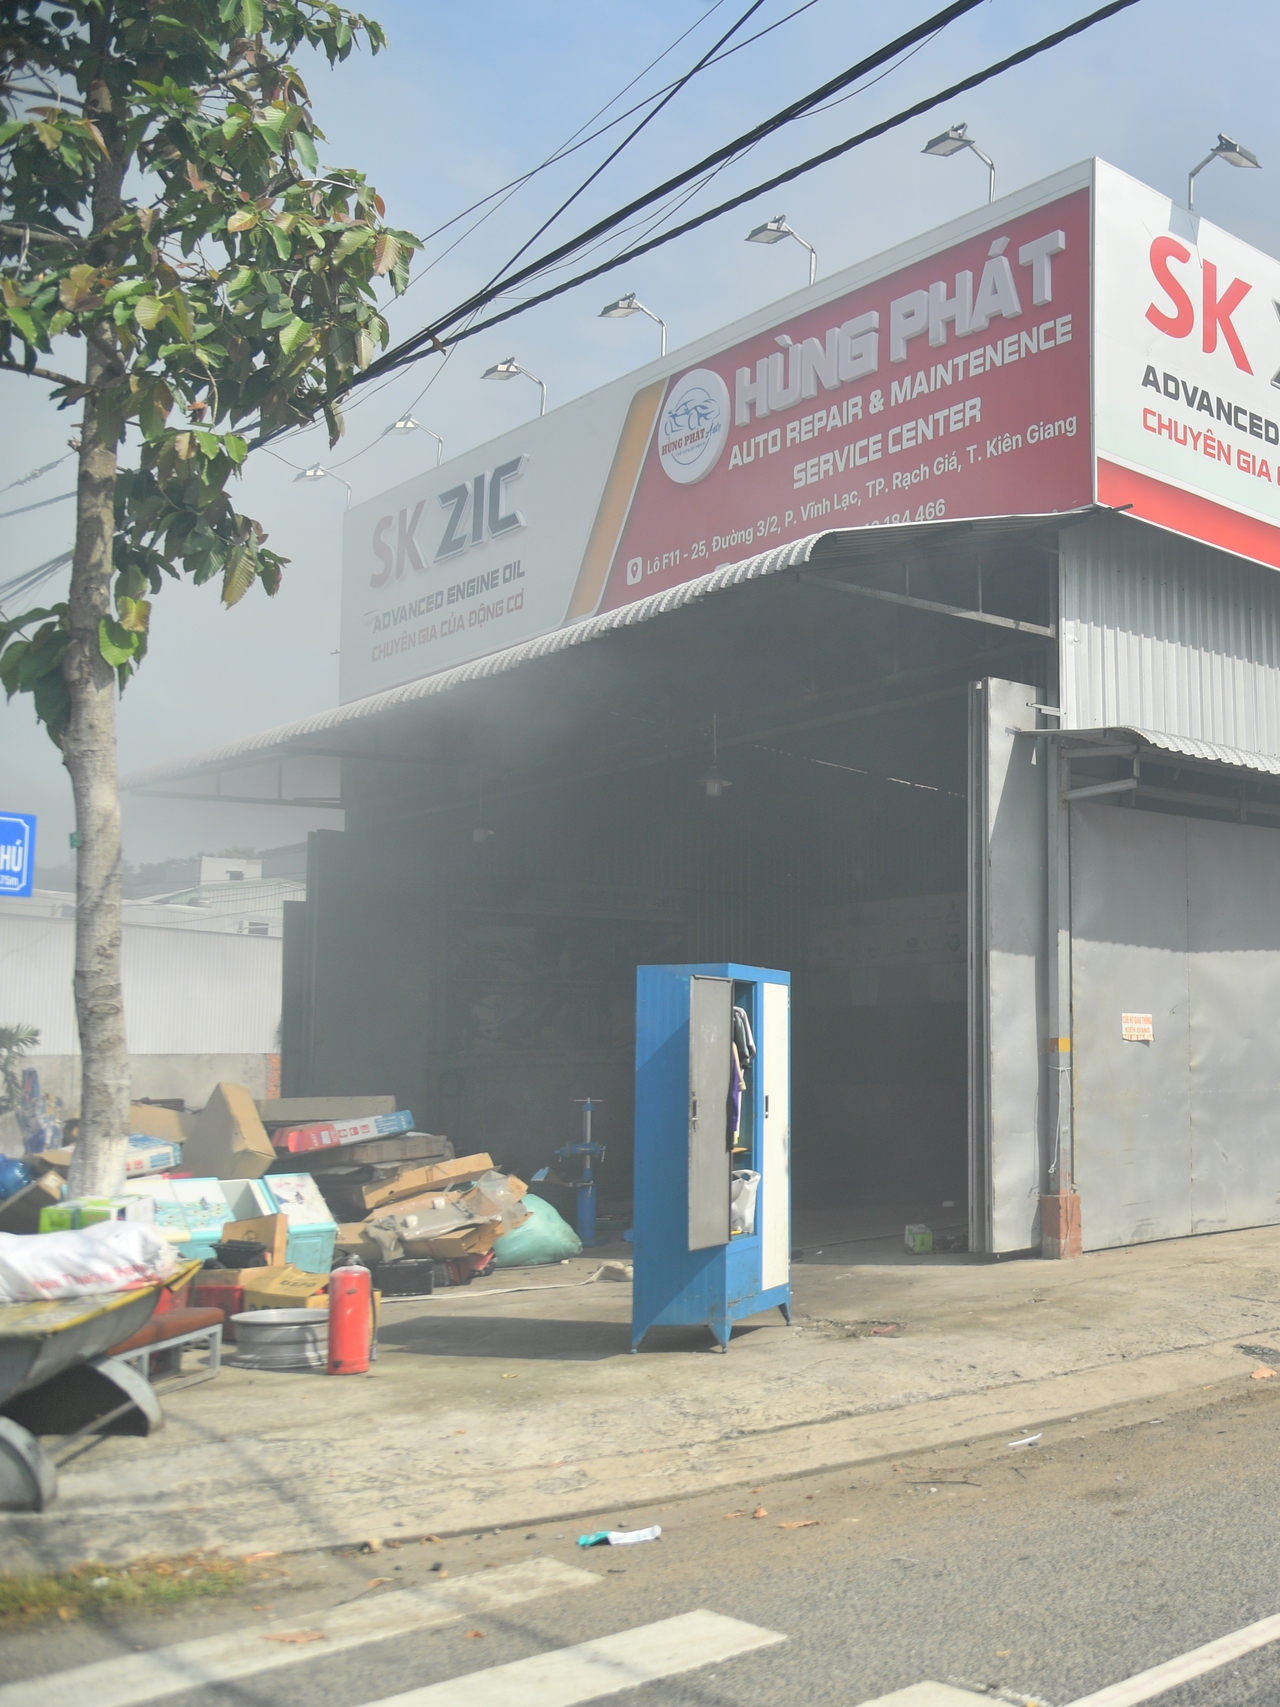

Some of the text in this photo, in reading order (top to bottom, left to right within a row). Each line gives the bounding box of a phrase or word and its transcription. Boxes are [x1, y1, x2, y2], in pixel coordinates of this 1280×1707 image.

[735, 229, 1065, 426] HÙNG PHÁT
[1144, 235, 1255, 377] SK
[728, 313, 1072, 471] AUTO REPAIR & MAINTENENCE
[1141, 364, 1280, 446] ADVANCED
[793, 396, 981, 490] SERVICE CENTER
[1142, 407, 1232, 466] CHUYÊN
[1237, 448, 1272, 483] GIA
[369, 453, 530, 589] SK ZIC
[647, 556, 660, 575] Lô
[663, 549, 681, 570] F11
[691, 539, 709, 559] 25,
[712, 527, 754, 553] Đường
[757, 515, 782, 537] 3/2,
[785, 509, 797, 528] P.
[801, 498, 831, 521] Vĩnh
[834, 489, 862, 511] Lạc,
[866, 476, 889, 499] TP.
[892, 462, 930, 491] Rạch
[933, 450, 962, 476] Giá,
[966, 445, 982, 465] T.
[986, 433, 1023, 459] Kiên
[1026, 415, 1078, 445] Giang
[915, 498, 946, 521] 466
[371, 588, 525, 663] CHUYÊN GIA CỦA ĐỘNG CƠ
[373, 560, 526, 634] ADVANCED ENGINE OIL
